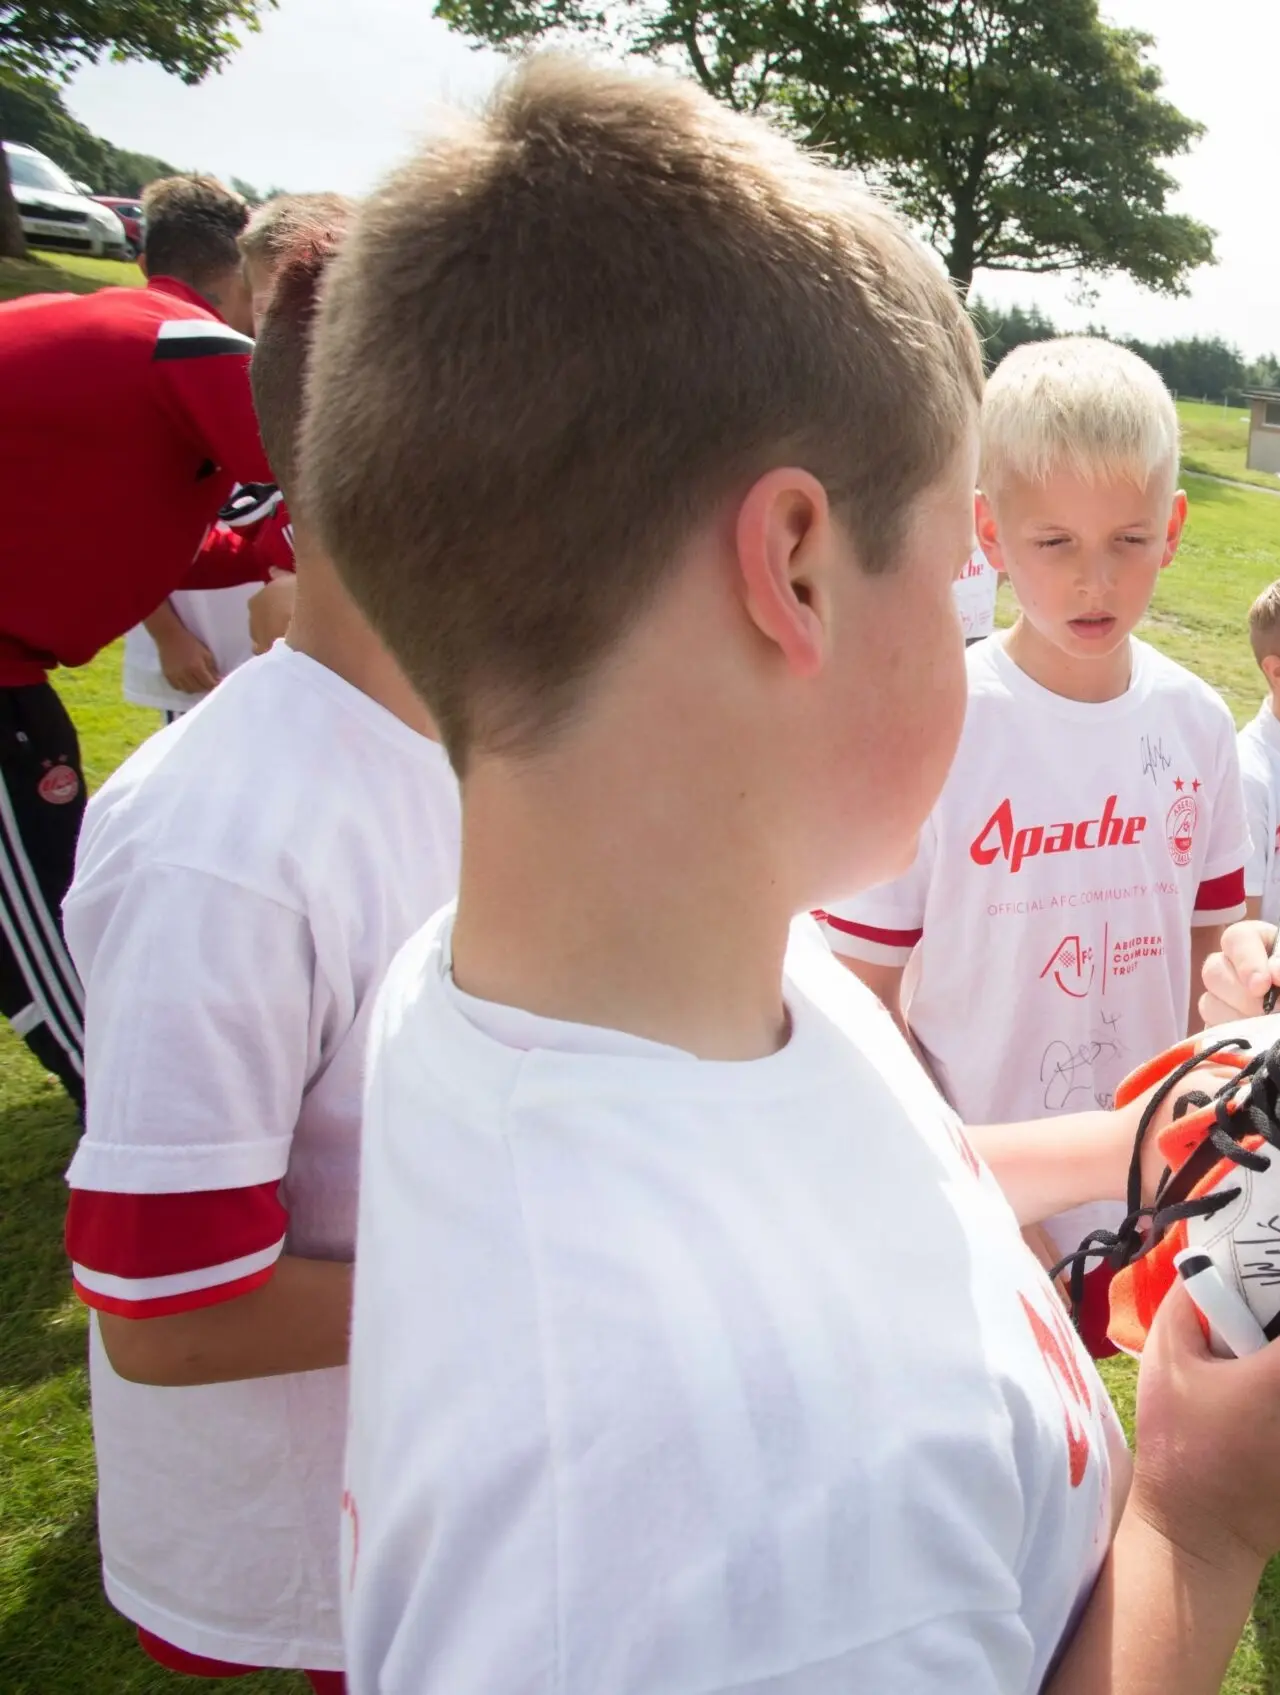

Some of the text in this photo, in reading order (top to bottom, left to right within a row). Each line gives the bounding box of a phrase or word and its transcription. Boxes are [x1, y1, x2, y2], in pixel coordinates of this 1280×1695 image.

[970, 795, 1147, 873] Apache
[987, 900, 1045, 917] OFFICIAL
[1050, 895, 1077, 909] AFC
